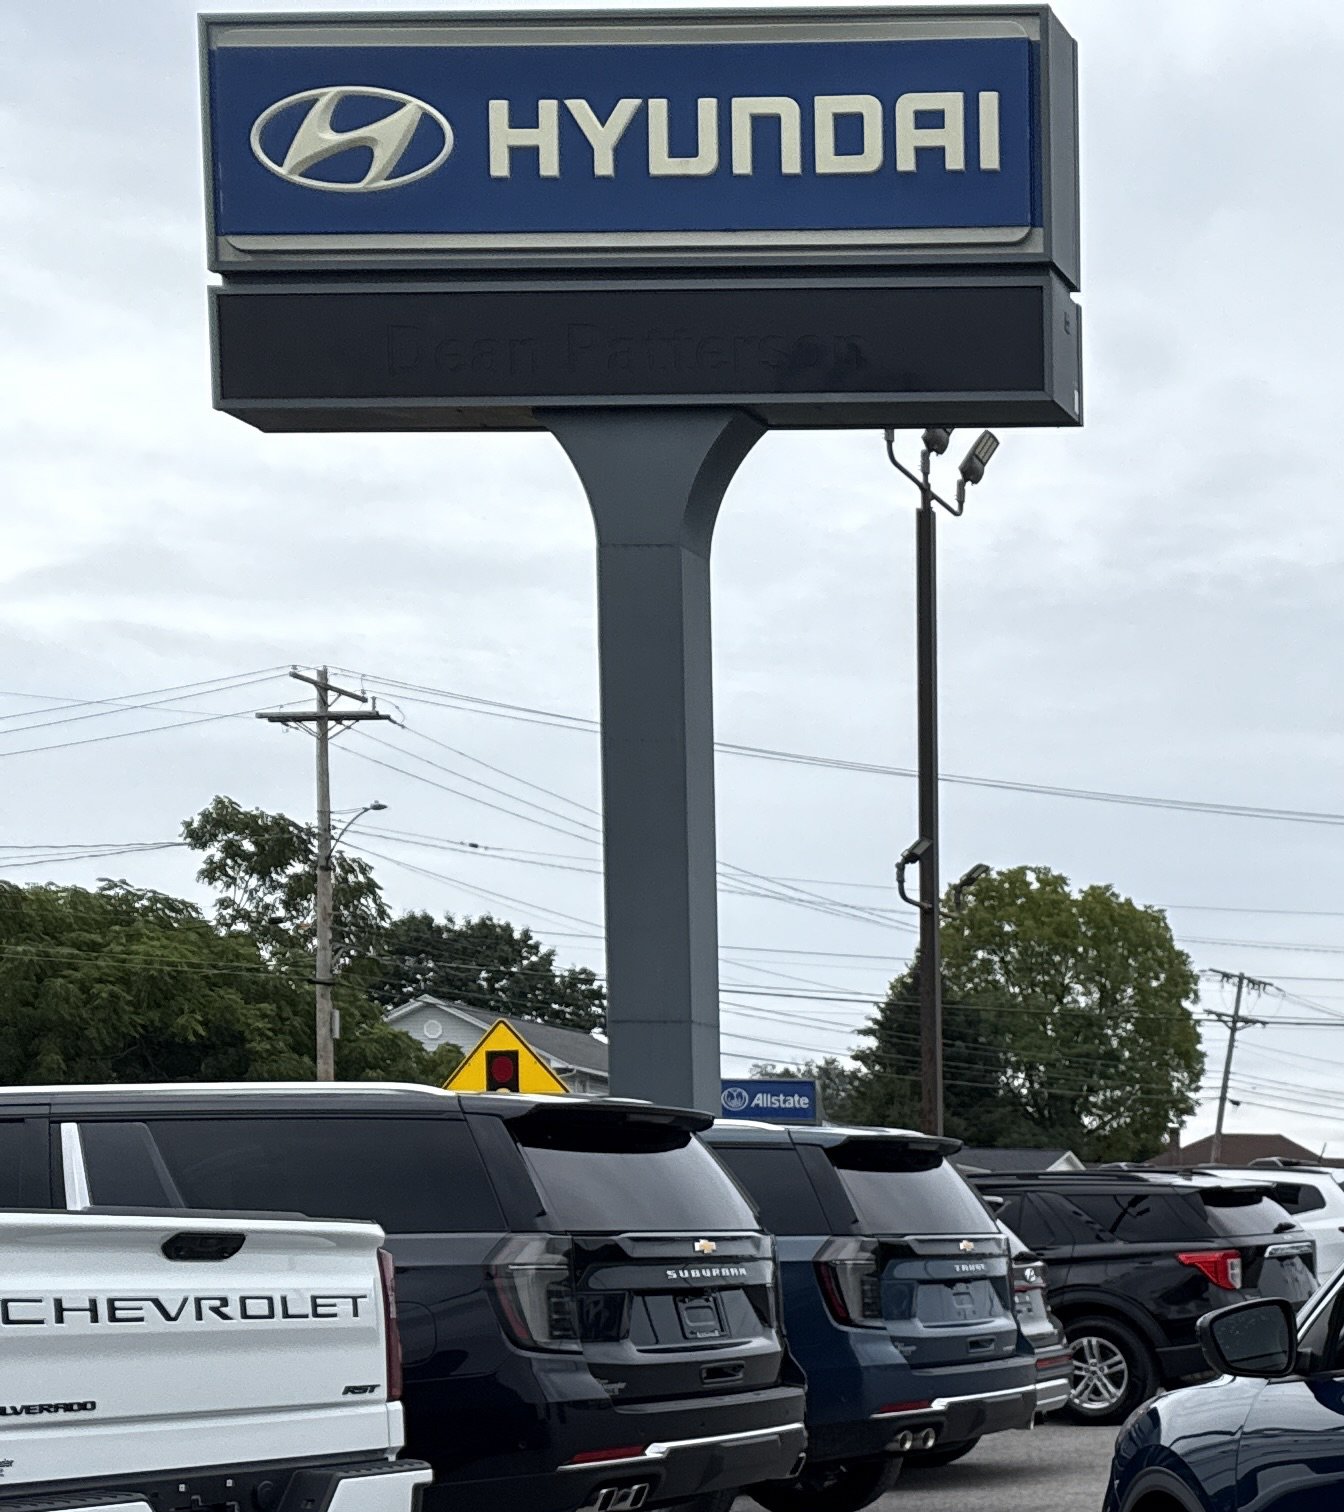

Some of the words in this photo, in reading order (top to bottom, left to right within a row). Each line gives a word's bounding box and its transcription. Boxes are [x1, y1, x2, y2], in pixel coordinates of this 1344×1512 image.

[489, 91, 1000, 178] HYUNDAI
[751, 1093, 809, 1108] Allstate
[666, 1267, 748, 1280] SUBURBAN
[1, 1294, 368, 1326] CHEVROLET
[342, 1384, 381, 1395] RST
[0, 1401, 96, 1416] LVERADO
